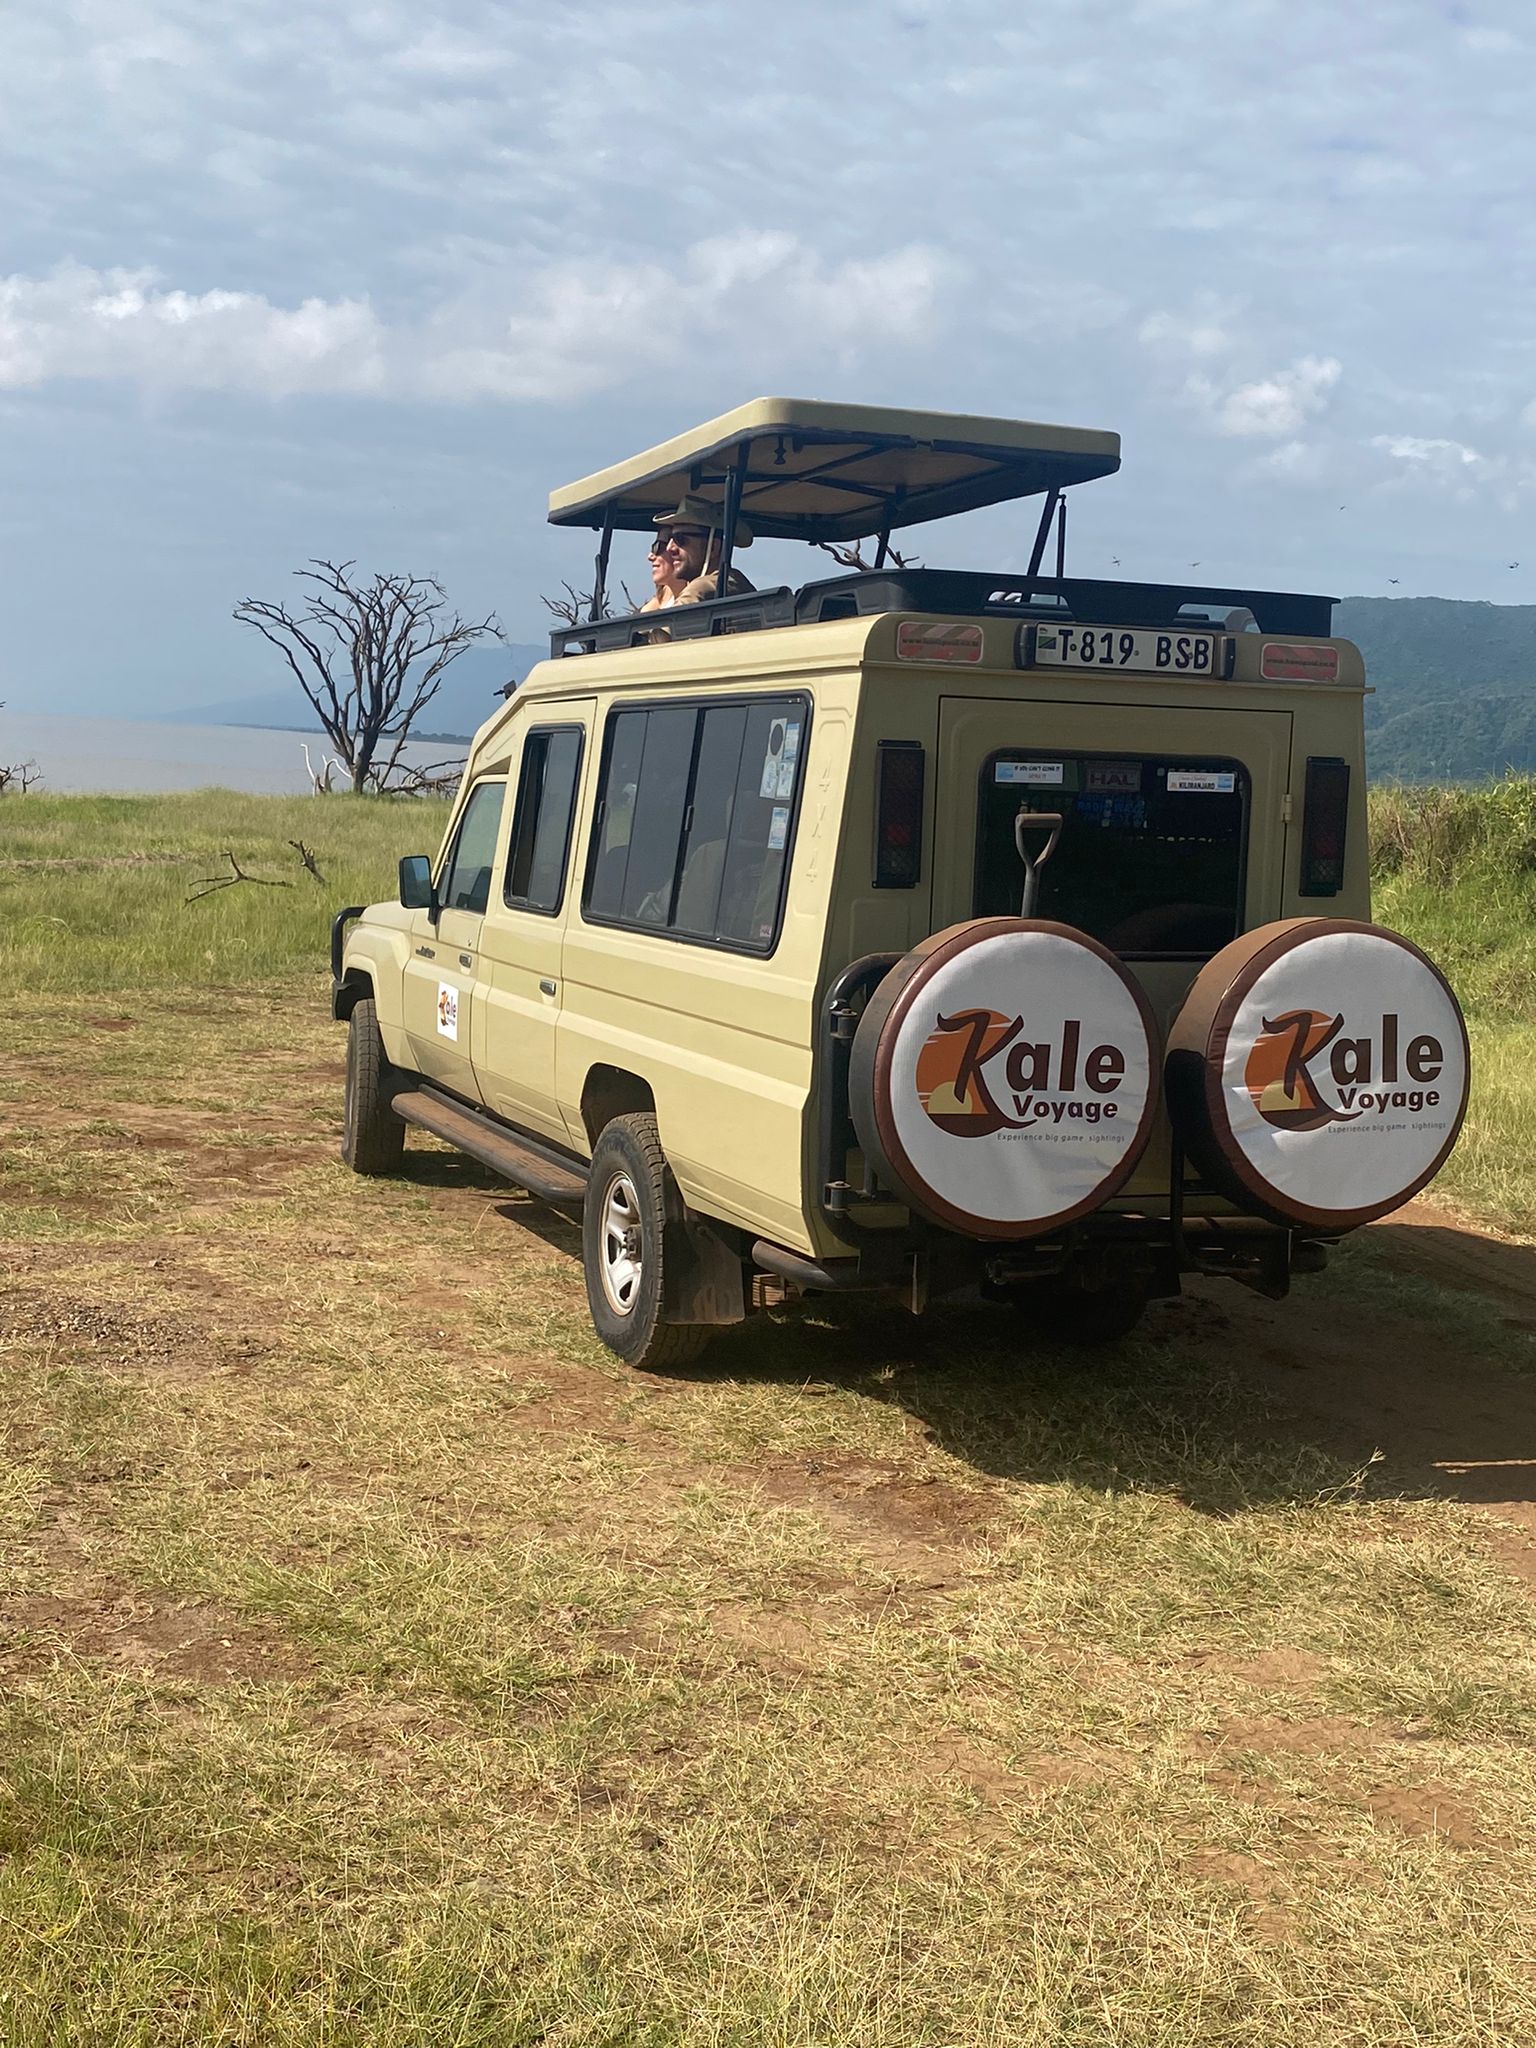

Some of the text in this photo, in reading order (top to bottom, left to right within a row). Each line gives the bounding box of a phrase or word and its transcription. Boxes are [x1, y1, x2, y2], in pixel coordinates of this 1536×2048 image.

[1155, 636, 1209, 669] BSB
[937, 1012, 1125, 1128] Kale
[1262, 1012, 1444, 1122] Kale
[1012, 1094, 1118, 1124] Voyage
[1336, 1087, 1441, 1114] Voyage
[997, 1133, 1125, 1143] Experience big game sightings
[1328, 1125, 1370, 1134] Experience
[1371, 1124, 1385, 1133] big
